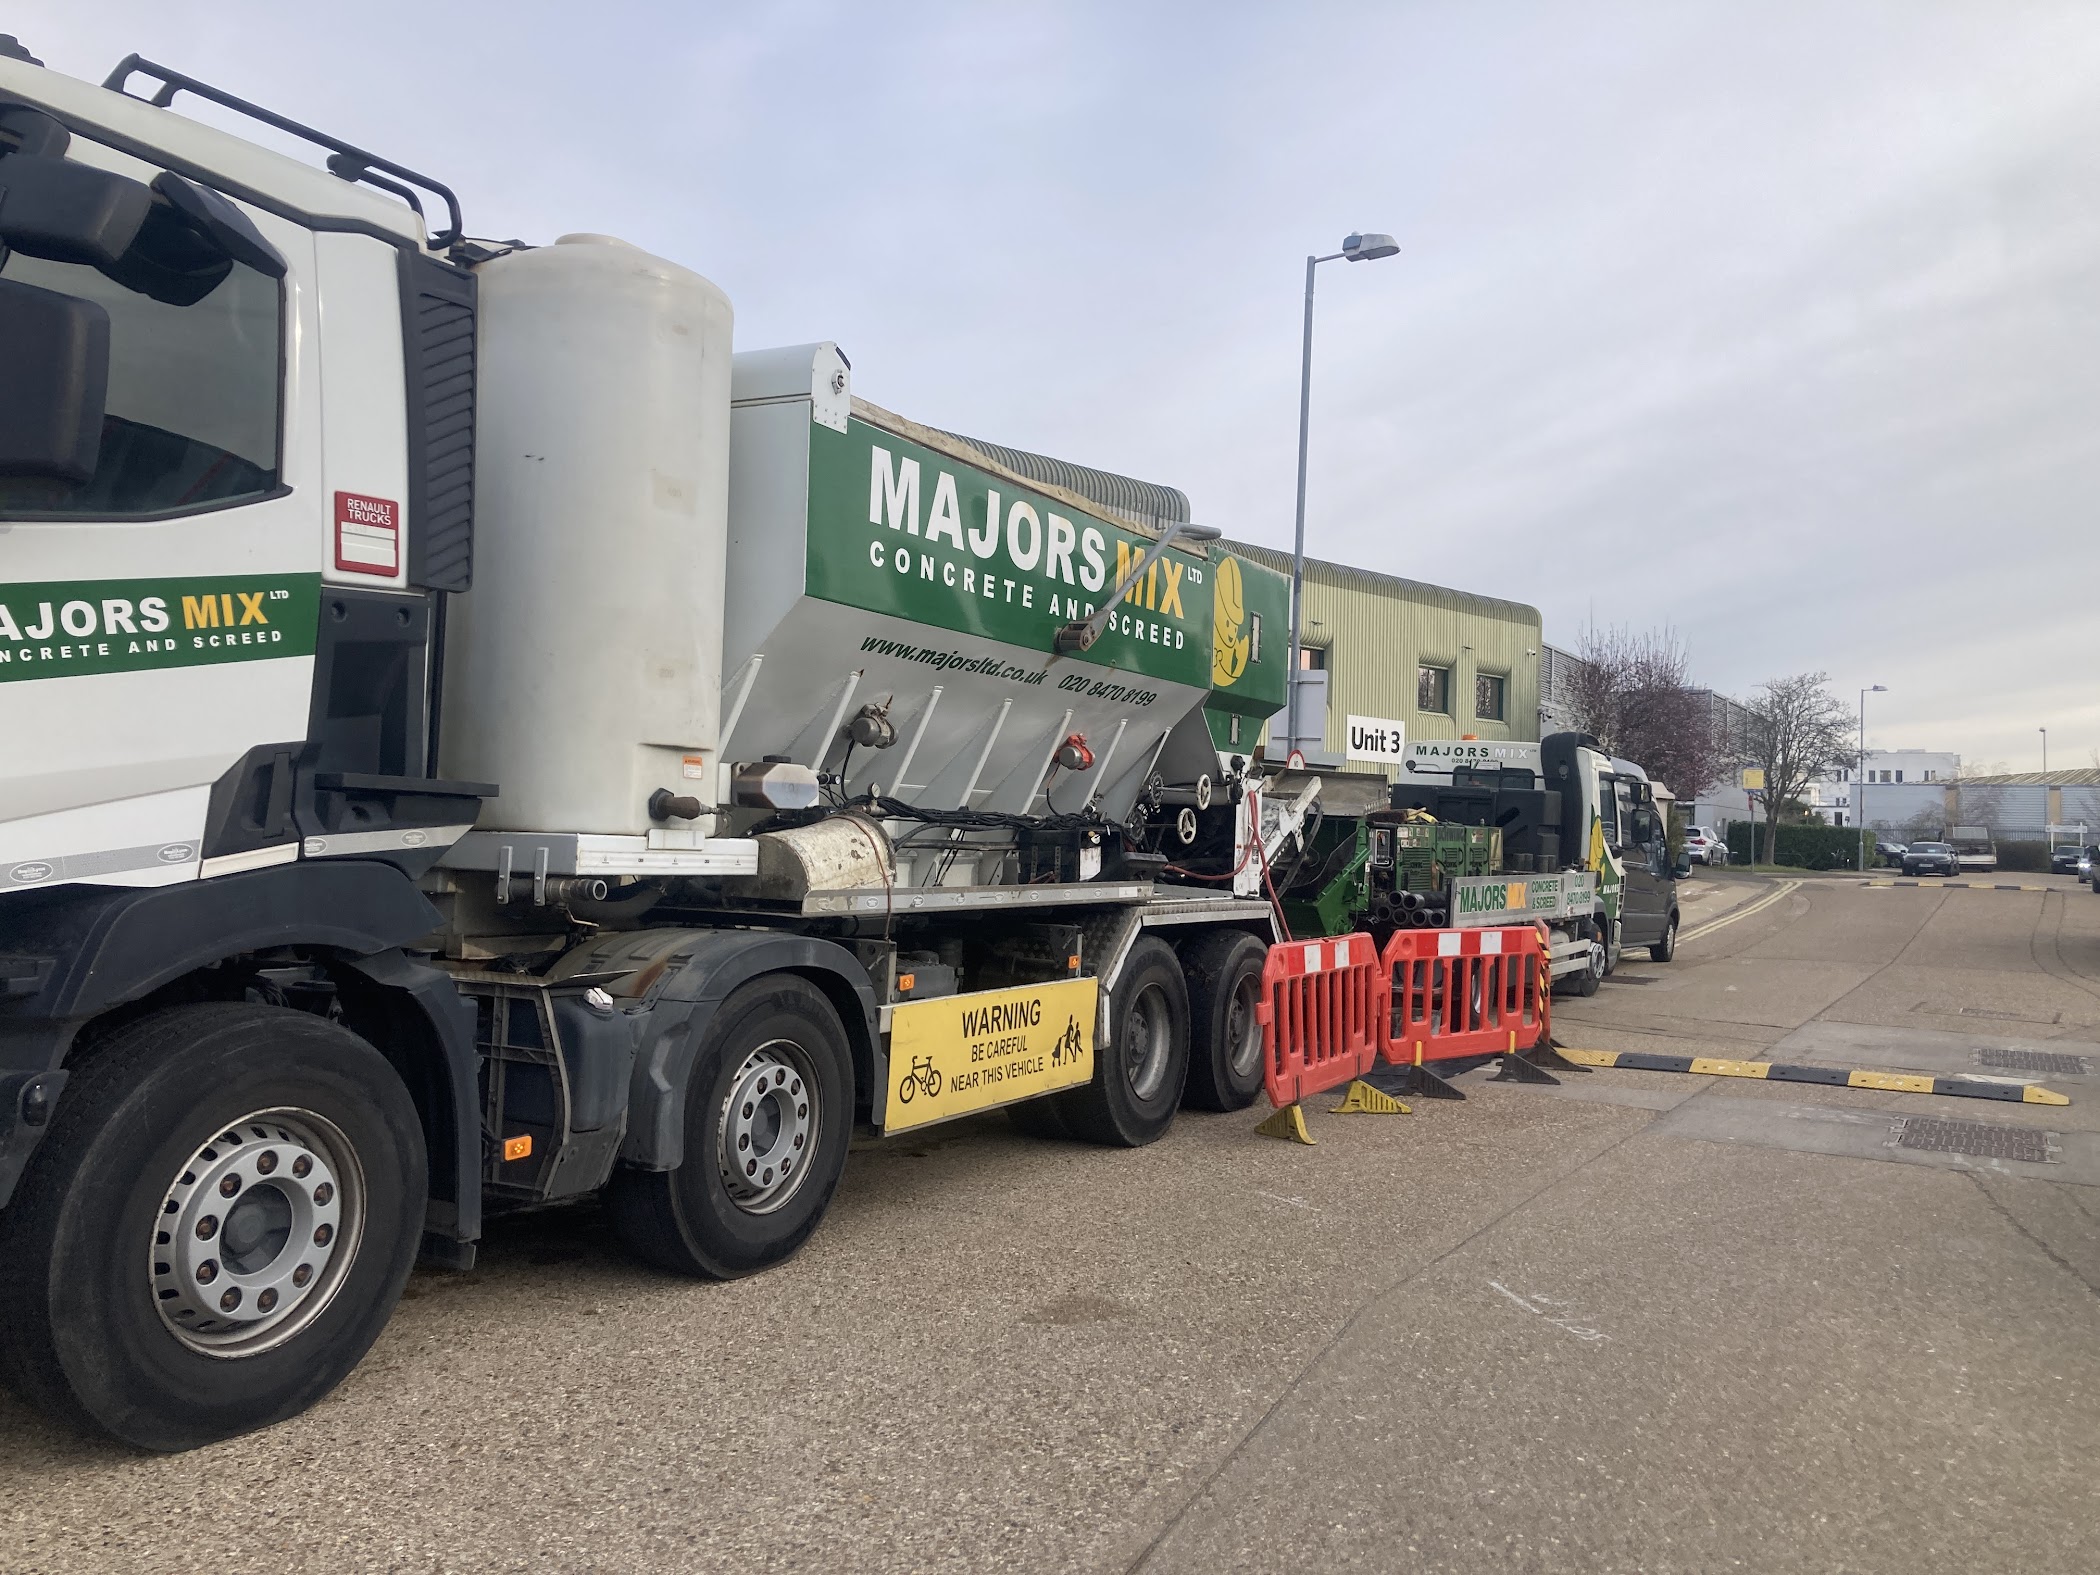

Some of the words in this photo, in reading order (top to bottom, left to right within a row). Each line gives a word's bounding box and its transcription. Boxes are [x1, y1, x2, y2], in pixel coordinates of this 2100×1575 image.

[347, 498, 391, 515] RENAULT
[347, 508, 391, 525] TRUCKS
[868, 444, 1106, 593] MAJORS
[1115, 539, 1184, 619] MIX
[1187, 566, 1202, 584] LTD
[869, 540, 1033, 609] CONCRETE
[1108, 610, 1184, 650] SCREED
[182, 592, 269, 630] MIX
[269, 590, 289, 600] LTD
[128, 639, 176, 654] AND
[193, 630, 283, 649] SCREED
[860, 636, 1049, 686] www.majorsltd.co.uk
[1057, 674, 1088, 692] 020
[1087, 681, 1125, 700] 8470
[1121, 689, 1157, 707] 8199
[1351, 726, 1387, 753] Unit
[1390, 730, 1400, 754] 3
[1416, 746, 1489, 757] MAJORS
[1494, 748, 1528, 759] MIX
[1459, 883, 1507, 913] MAJORS
[1507, 882, 1527, 910] MIX
[1531, 880, 1558, 893] CONCRETE
[962, 999, 1041, 1038] WARNING
[971, 1043, 984, 1062] BE
[986, 1035, 1028, 1058] CAREFUL
[950, 1071, 979, 1093] NEAR
[981, 1066, 1003, 1087] THIS
[1005, 1056, 1044, 1080] VEHICLE
